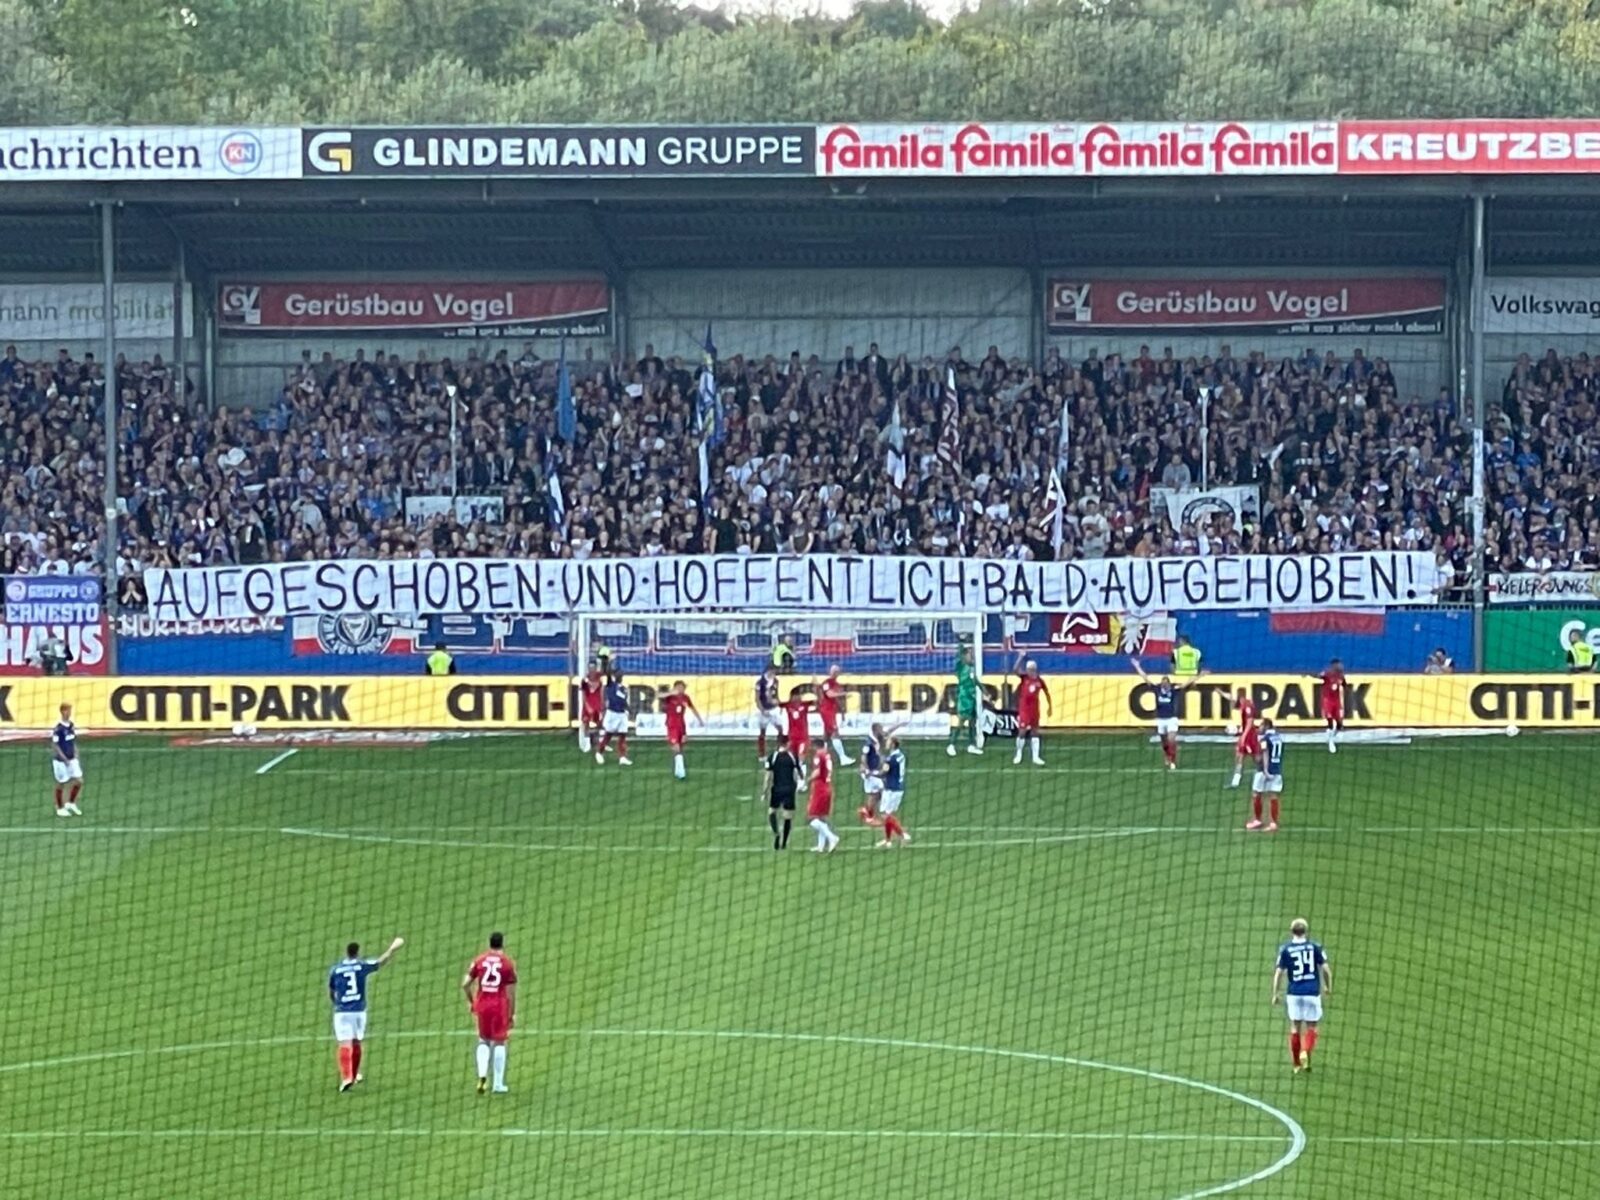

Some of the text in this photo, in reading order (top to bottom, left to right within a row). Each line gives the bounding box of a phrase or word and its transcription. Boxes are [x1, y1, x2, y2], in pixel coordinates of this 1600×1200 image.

[228, 144, 255, 162] KN
[373, 136, 803, 168] GLINDEMANN GRUPPE
[820, 123, 943, 173] famila
[950, 123, 1074, 173] famila
[1080, 123, 1204, 173] famila
[1210, 123, 1334, 173] famila
[1346, 132, 1600, 161] KREUTZBE
[285, 292, 514, 322] Gerüstbau Vogel
[1116, 288, 1349, 319] Gerüstbau Vogel
[1491, 295, 1600, 319] Volkswag
[1100, 553, 1417, 607] AUFGEHOBEN!
[447, 684, 672, 722] CITTI-R
[789, 683, 1020, 714] CTTI-PA
[1128, 682, 1373, 721] CTTIPAK
[481, 961, 502, 987] 25
[1291, 950, 1315, 976] 34
[343, 971, 358, 996] 3
